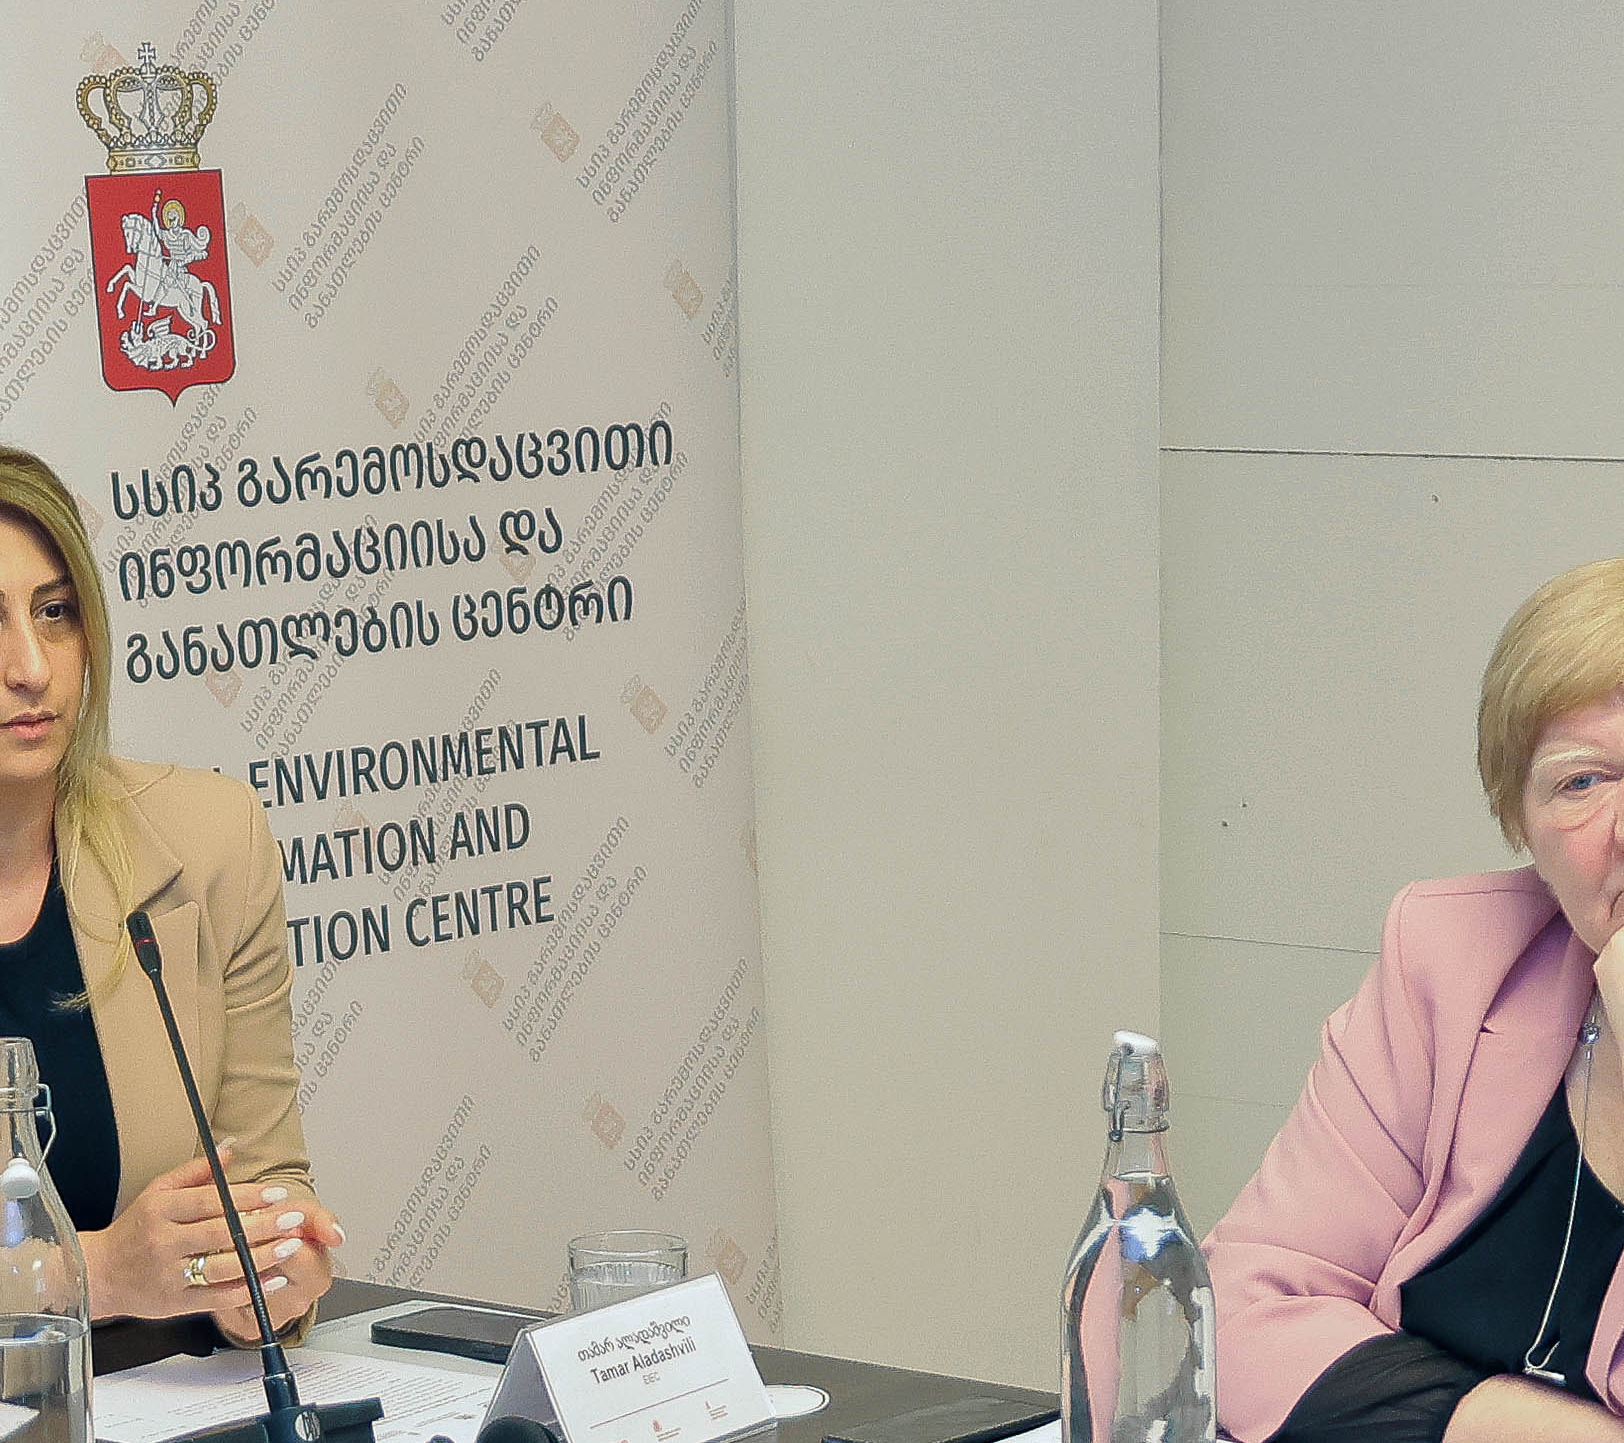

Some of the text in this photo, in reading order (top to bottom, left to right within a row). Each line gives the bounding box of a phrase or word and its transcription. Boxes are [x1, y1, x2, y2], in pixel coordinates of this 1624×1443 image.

[594, 47, 698, 206] ინფორმაციისა და
[610, 110, 685, 223] განათლების
[269, 83, 412, 292] სსიპ გარემოსდაცვითი
[577, 146, 610, 188] სსიპ
[60, 248, 85, 275] და
[288, 143, 401, 310] ინფორმაციისა და
[305, 136, 426, 328] განათლების ცენტრი
[433, 244, 541, 409] გარემოსდაცვითი
[506, 305, 527, 331] და
[507, 297, 558, 368] ცენტრი
[206, 415, 227, 442] და
[111, 462, 224, 521] სსიპ
[237, 420, 673, 508] გარემოსდაცვითი
[640, 452, 688, 524] ცენტრი
[118, 514, 486, 602] ინფორმაციისა
[500, 507, 563, 556] და
[345, 574, 367, 601] და
[126, 599, 440, 684] განათლების
[453, 575, 633, 642] ცენტრი
[249, 715, 601, 808] ENVIRONMENTAL
[665, 713, 695, 757] სსიპ
[277, 818, 434, 885] MATION
[449, 802, 531, 860] AND
[405, 875, 555, 947] CENTRE
[501, 819, 628, 1030] სსიპ გარემოსდაცვითი
[512, 877, 617, 1045] ინფორმაციისა და
[528, 867, 647, 1059] განათლების ცენტრი
[312, 1012, 334, 1037] და
[314, 1000, 364, 1078] ცენტრი
[373, 1095, 475, 1272] გარემოსდაცვითი
[446, 1156, 465, 1182] და
[448, 1144, 491, 1221] ცენტრი
[577, 1316, 691, 1361] თამარ ალადაშვილი
[590, 1336, 697, 1384] Tamar Aladashvili
